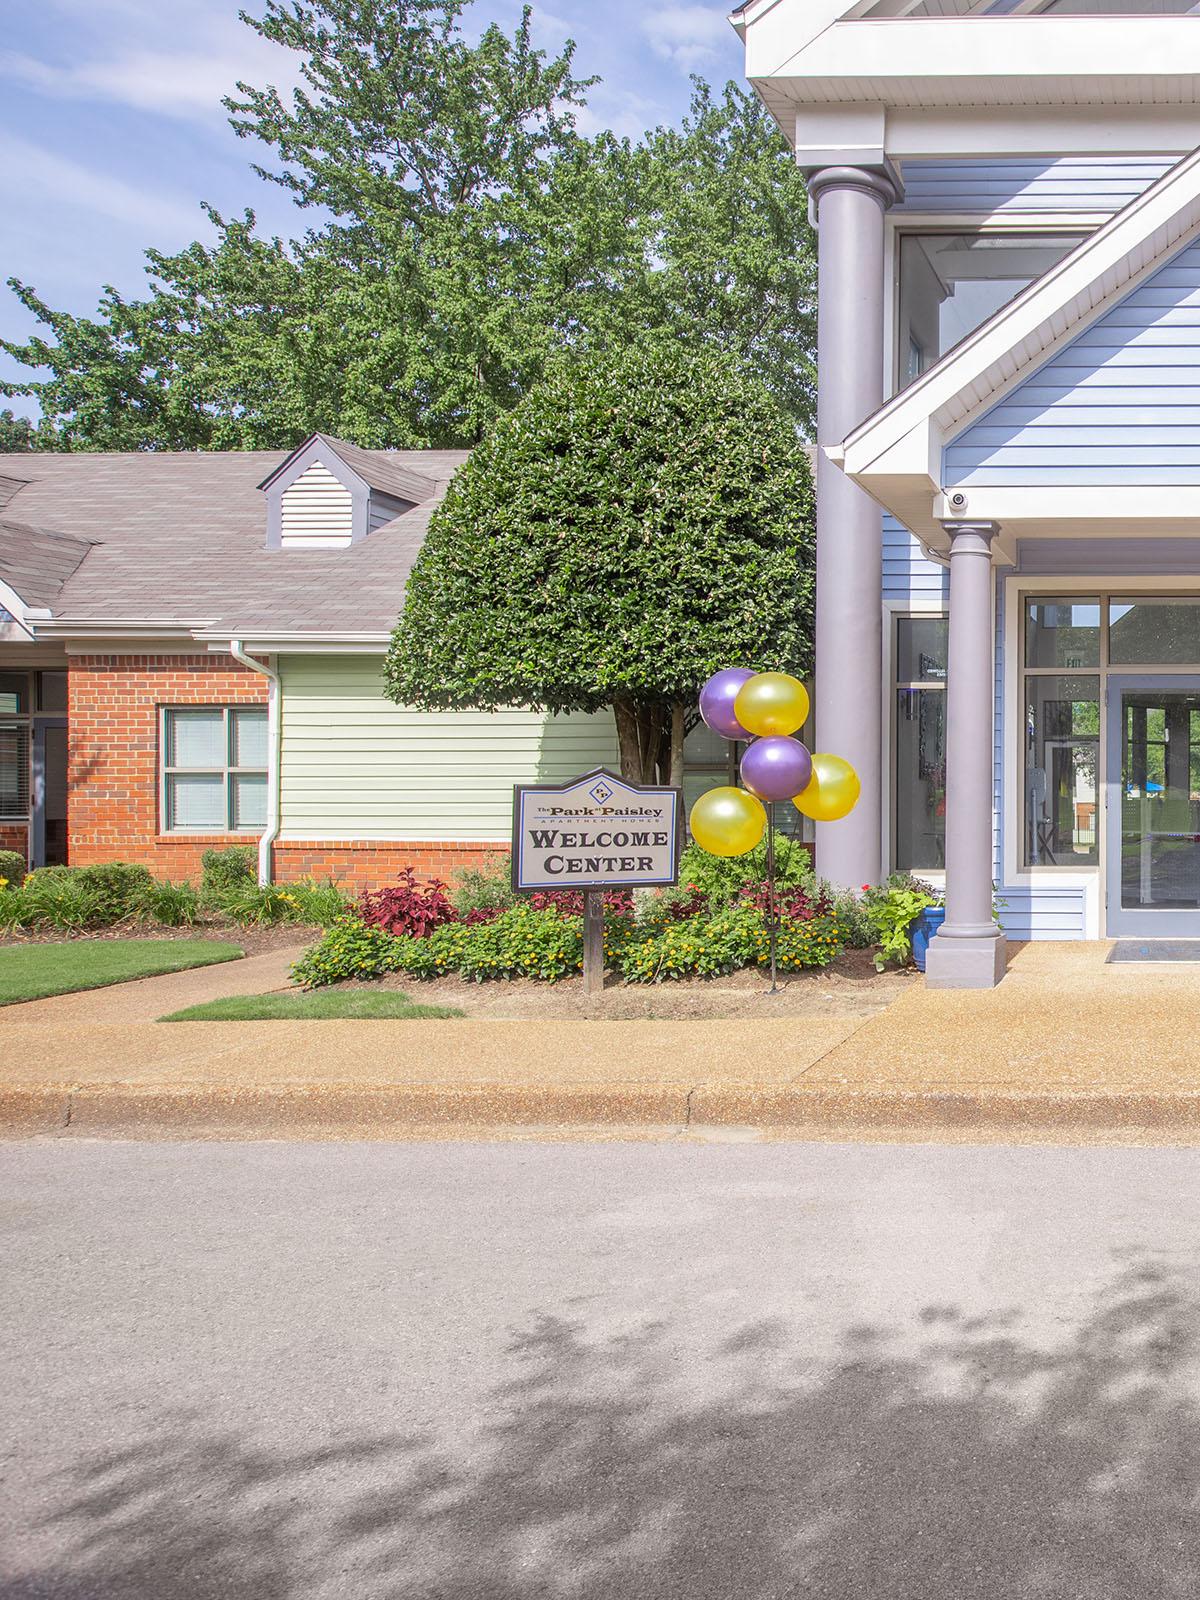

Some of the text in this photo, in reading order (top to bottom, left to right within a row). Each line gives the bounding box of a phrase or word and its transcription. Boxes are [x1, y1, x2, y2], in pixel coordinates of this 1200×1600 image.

[550, 807, 594, 816] Park
[602, 807, 663, 817] Paisley
[528, 830, 668, 848] WELCOME
[544, 855, 654, 874] CENTER
